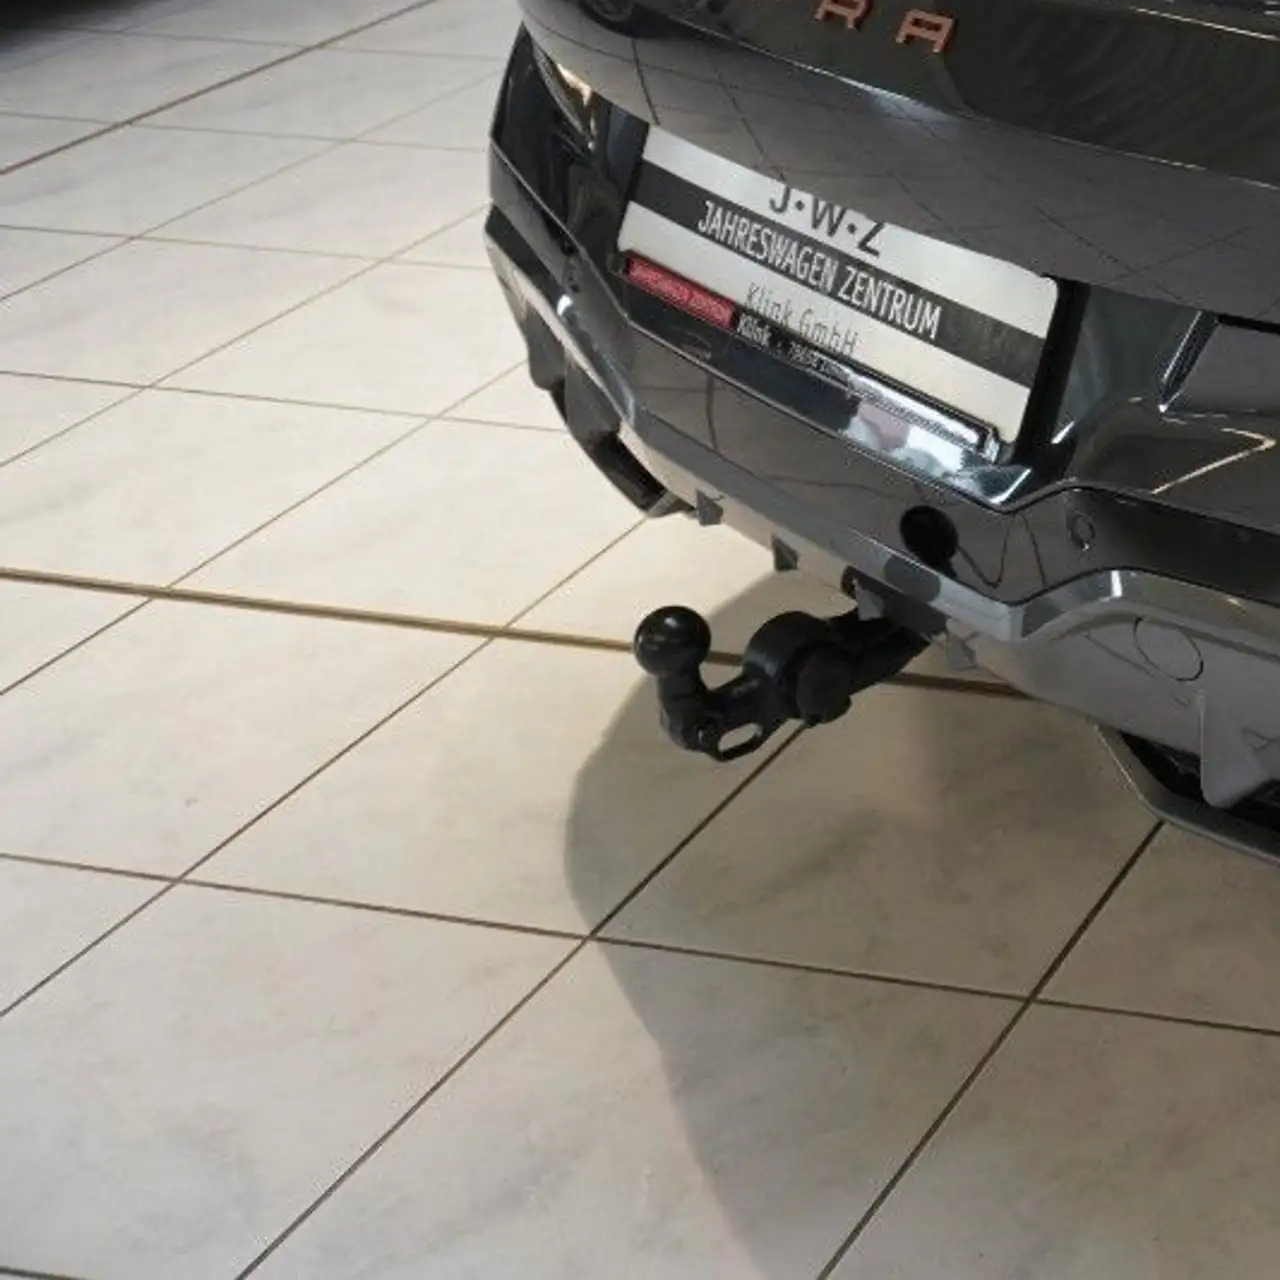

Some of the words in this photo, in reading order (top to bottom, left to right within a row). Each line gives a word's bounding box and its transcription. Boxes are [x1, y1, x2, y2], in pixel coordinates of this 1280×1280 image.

[698, 200, 839, 294] JAHRESWAGEN
[837, 266, 942, 341] ZENTRUM
[799, 308, 859, 355] GmbH
